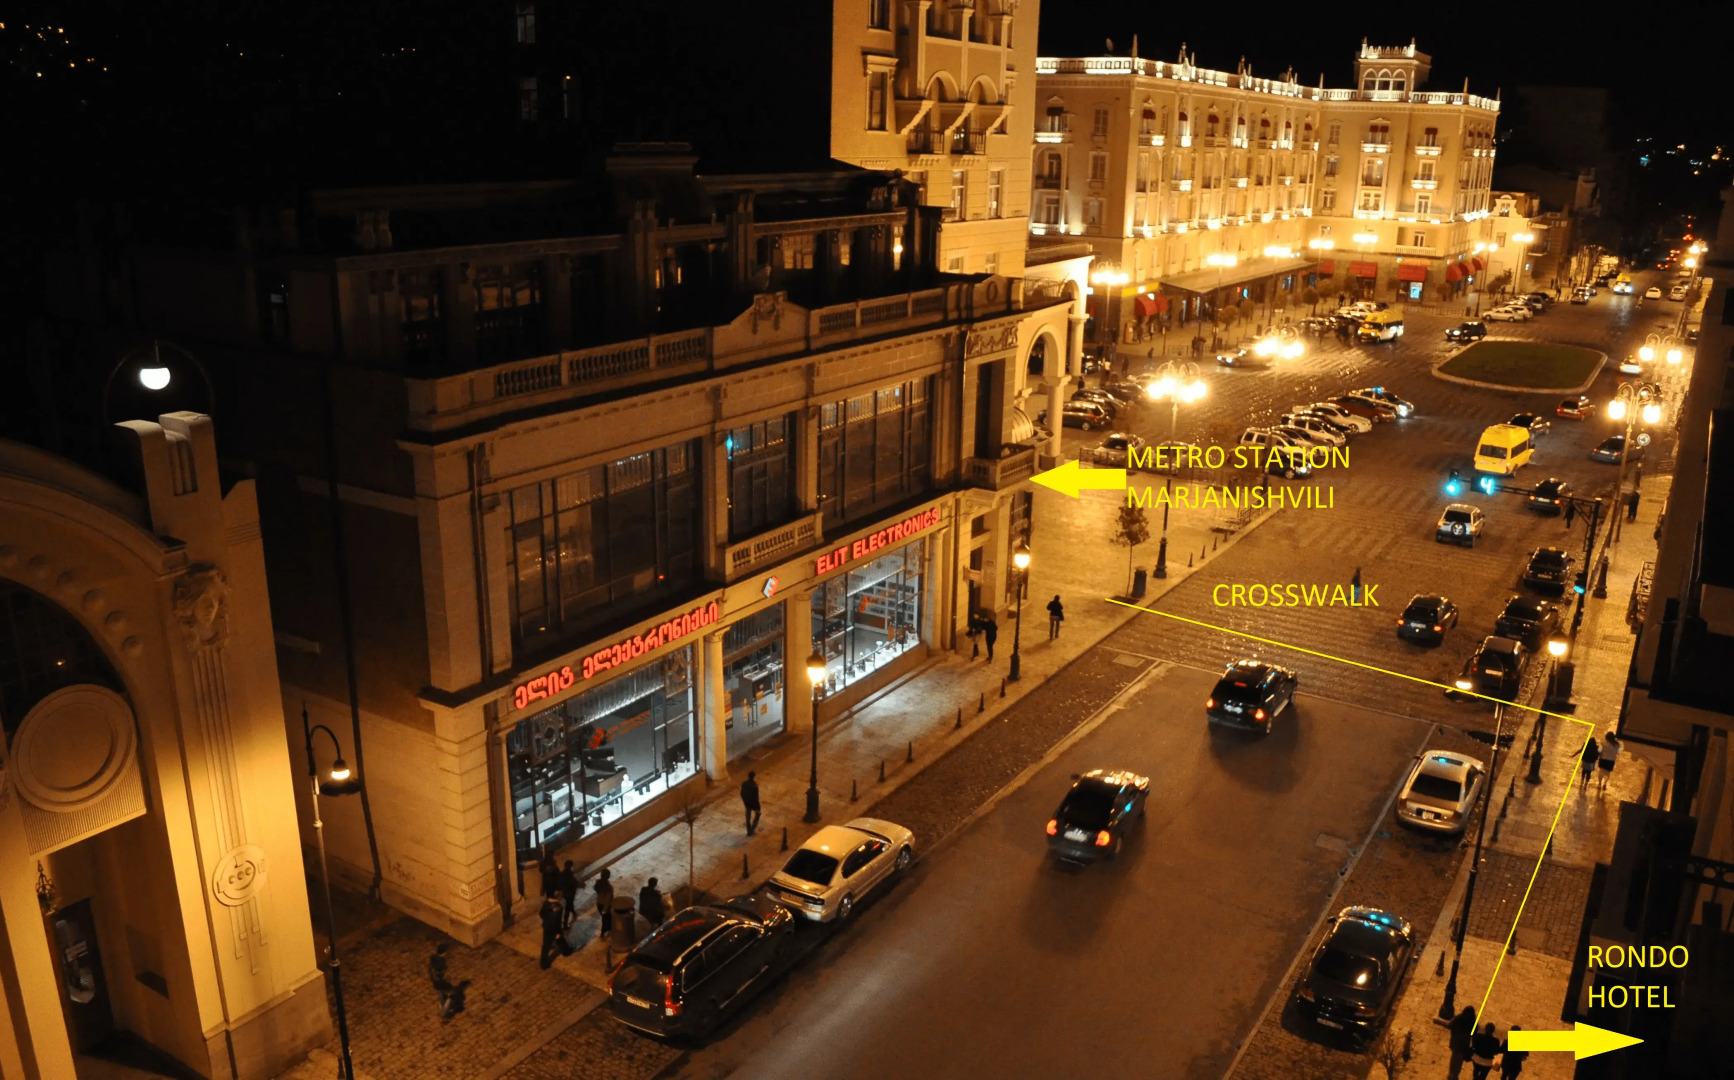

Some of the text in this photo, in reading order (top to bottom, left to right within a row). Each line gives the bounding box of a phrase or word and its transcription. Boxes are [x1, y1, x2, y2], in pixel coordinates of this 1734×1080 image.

[816, 507, 940, 576] ELIT ELECTRONICS
[514, 601, 719, 710] ელიტ ელექტრონიქსი
